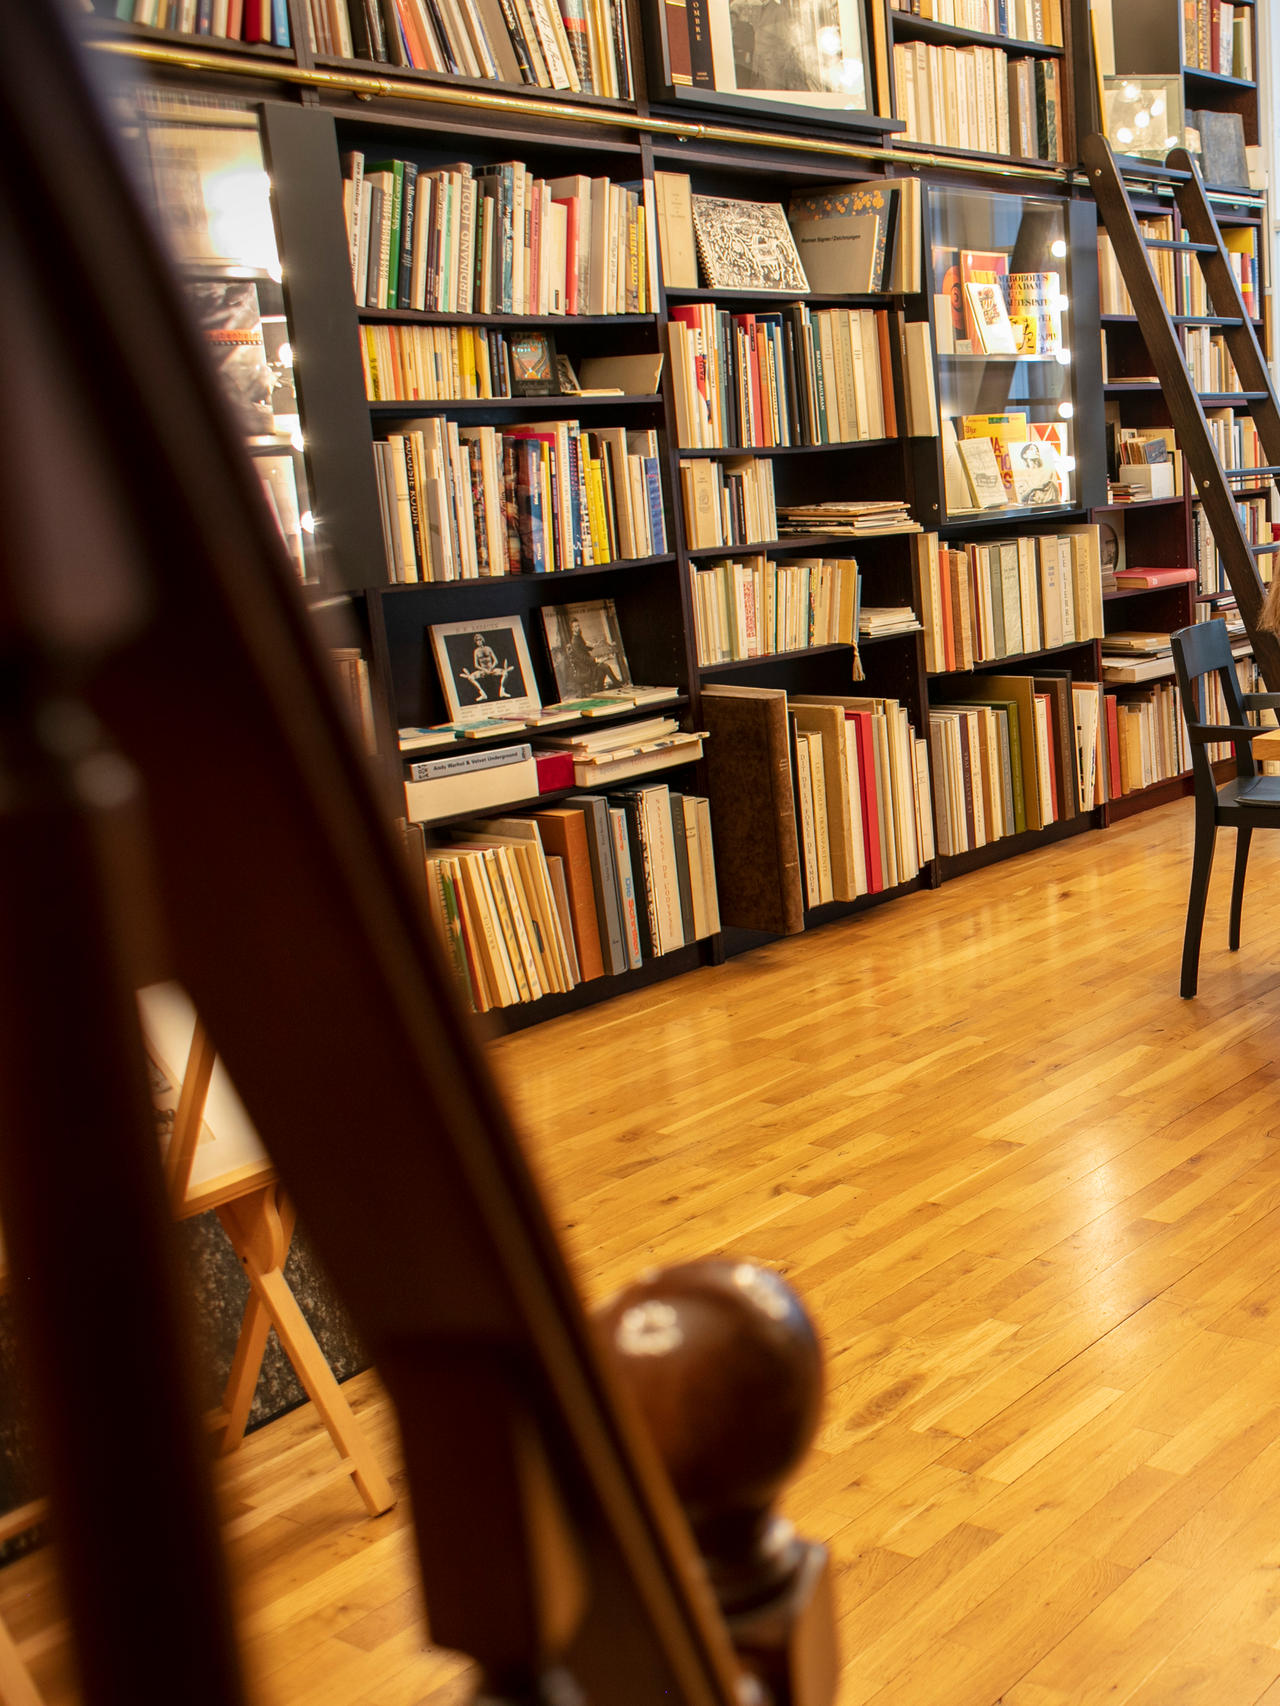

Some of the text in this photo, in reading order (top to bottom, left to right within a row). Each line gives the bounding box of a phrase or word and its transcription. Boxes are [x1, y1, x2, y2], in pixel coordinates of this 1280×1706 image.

[458, 170, 473, 306] FERDINAND HODLER
[404, 439, 415, 488] AUGUSTE
[433, 765, 446, 773] Andy
[448, 761, 465, 769] Warhol
[472, 757, 487, 765] Velvet
[488, 751, 518, 763] Underground
